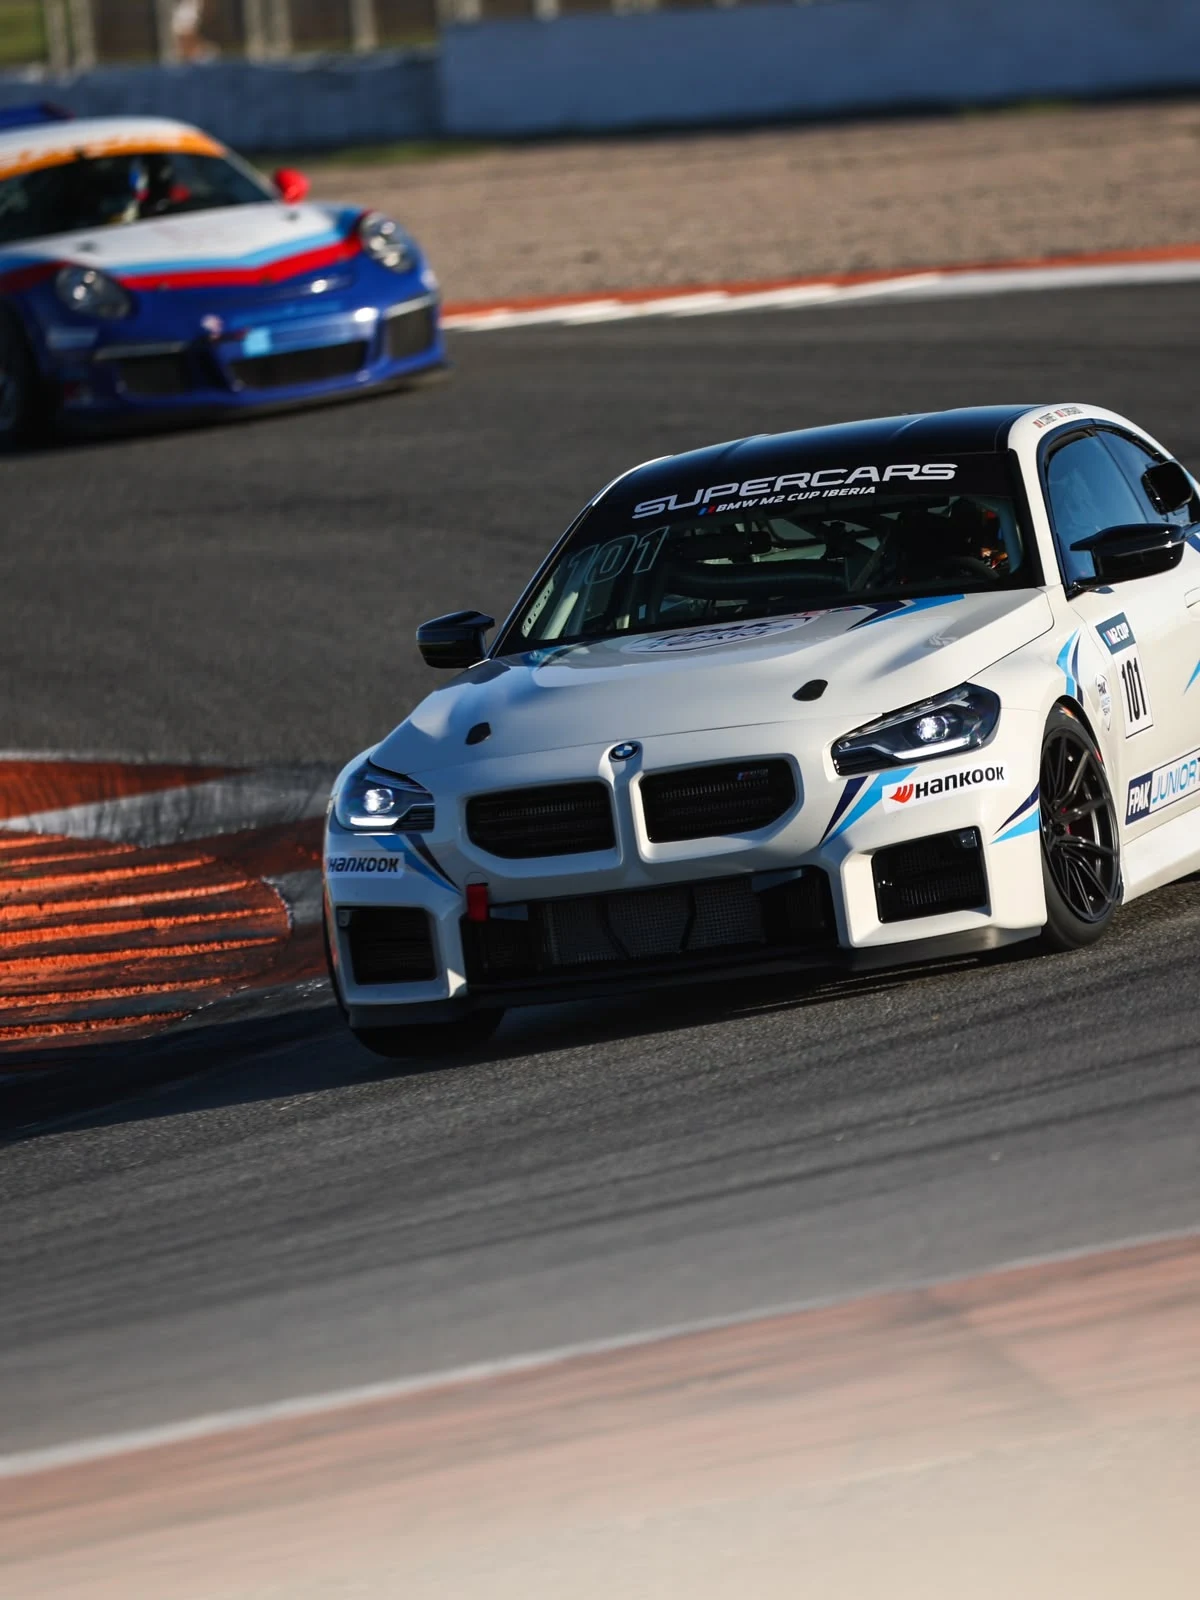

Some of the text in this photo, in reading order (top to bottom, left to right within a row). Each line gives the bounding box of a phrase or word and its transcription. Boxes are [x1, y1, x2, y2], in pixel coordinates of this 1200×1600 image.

[632, 463, 958, 519] SUPERCARS
[716, 486, 876, 512] BMW M2 CUP IBERIA
[560, 526, 670, 594] 101
[1121, 657, 1147, 722] 101
[1128, 781, 1151, 816] FPAK
